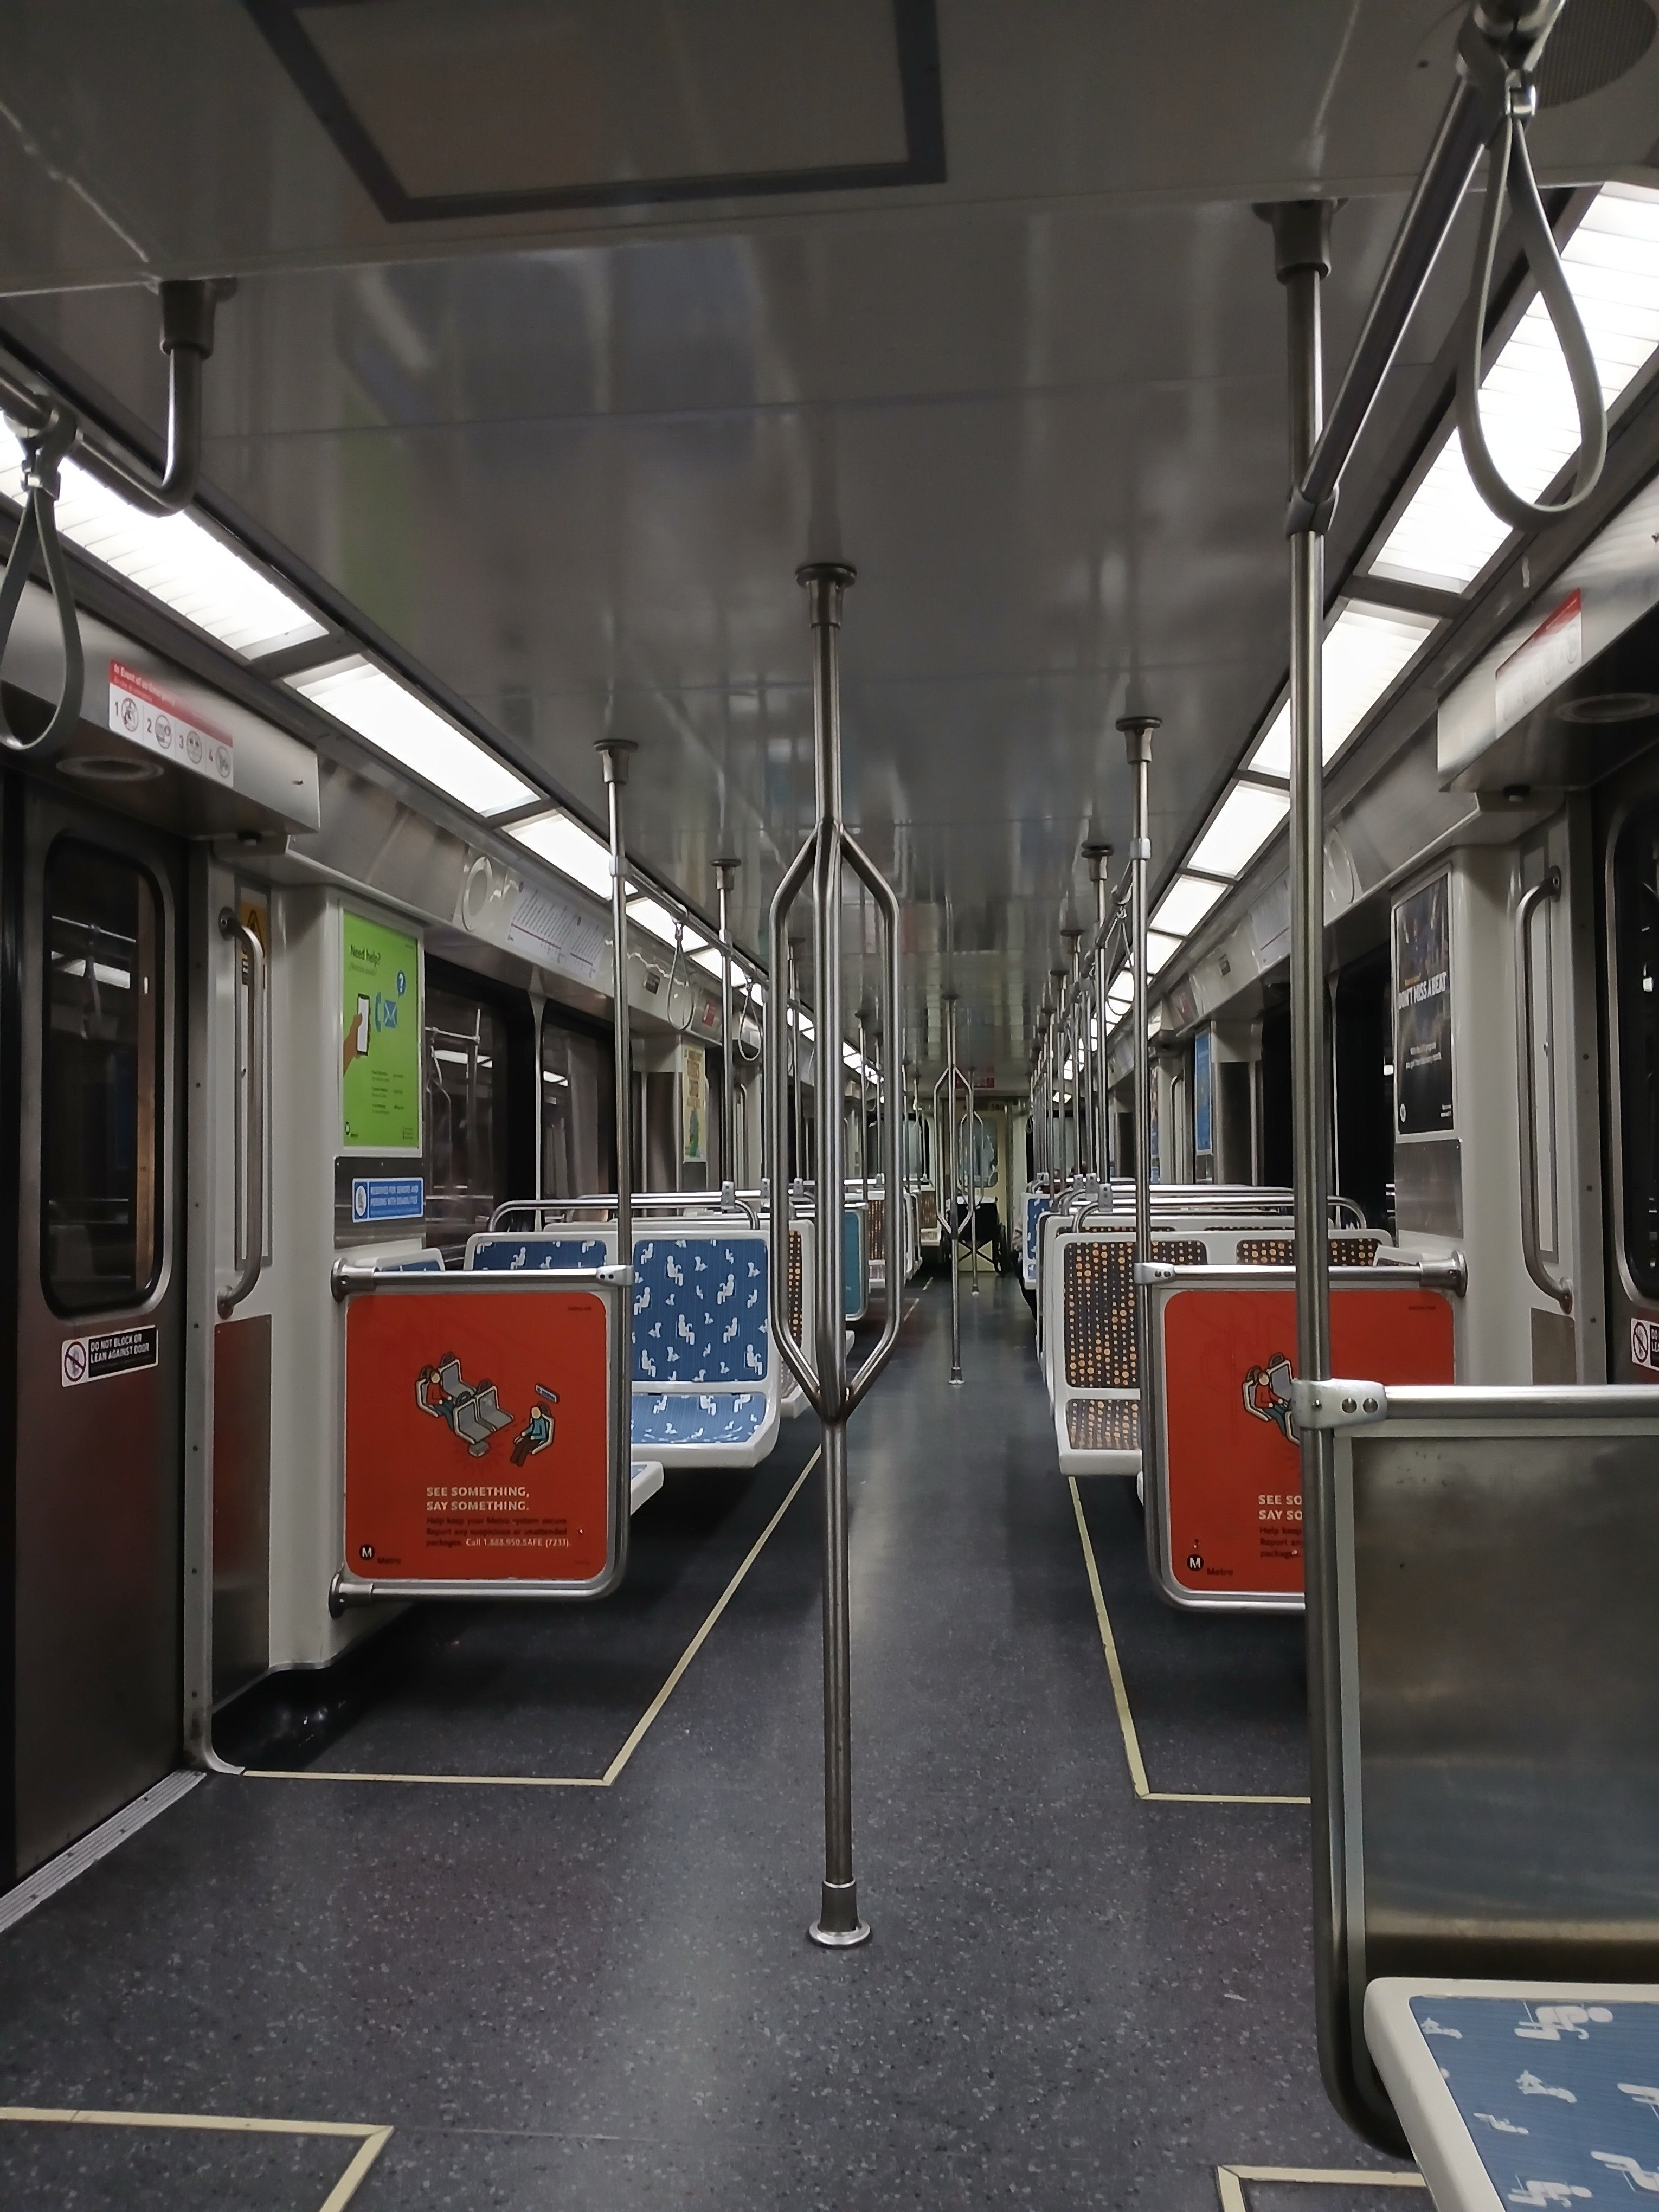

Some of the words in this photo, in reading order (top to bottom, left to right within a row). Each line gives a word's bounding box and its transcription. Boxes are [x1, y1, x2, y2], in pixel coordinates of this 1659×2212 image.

[115, 702, 119, 716] 1
[146, 718, 152, 733] 2
[179, 735, 184, 749] 3
[208, 749, 214, 762] 4
[91, 1341, 99, 1352] DO
[100, 1338, 113, 1349] NOT
[114, 1335, 133, 1347] BLOCK
[134, 1333, 142, 1343] OR
[91, 1352, 107, 1364] LEAN
[108, 1346, 133, 1359] AGAINST
[134, 1342, 149, 1354] DOOR
[426, 1487, 448, 1496] SEE
[451, 1487, 529, 1498] SOMETHING,
[1258, 1495, 1282, 1505] SEE
[426, 1501, 448, 1510] SAY
[451, 1501, 529, 1510] SOMETHING.
[1259, 1510, 1283, 1520] SAY
[466, 1538, 480, 1546] Call
[1207, 1567, 1233, 1576] Metro
